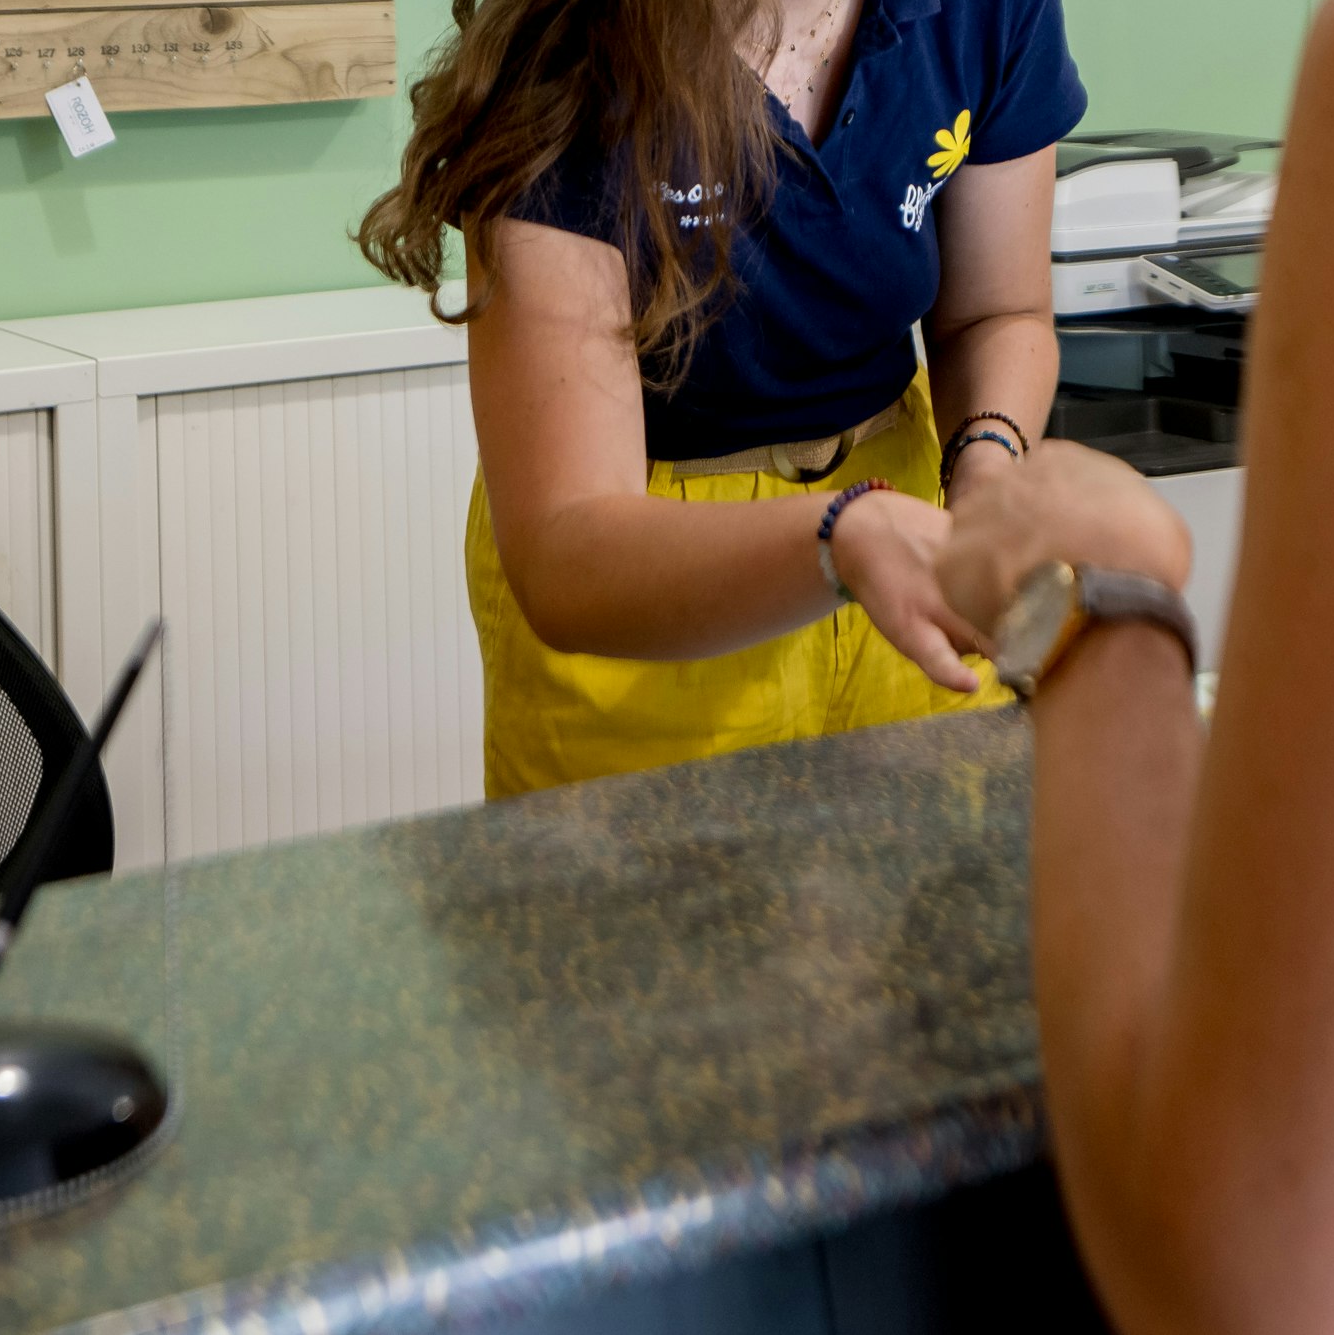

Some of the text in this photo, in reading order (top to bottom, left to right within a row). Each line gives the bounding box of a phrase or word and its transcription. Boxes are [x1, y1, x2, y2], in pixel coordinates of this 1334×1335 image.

[37, 47, 56, 58] 127
[67, 47, 85, 57] 128
[100, 45, 120, 56] 129
[131, 43, 151, 54] 130
[192, 42, 210, 52] 132
